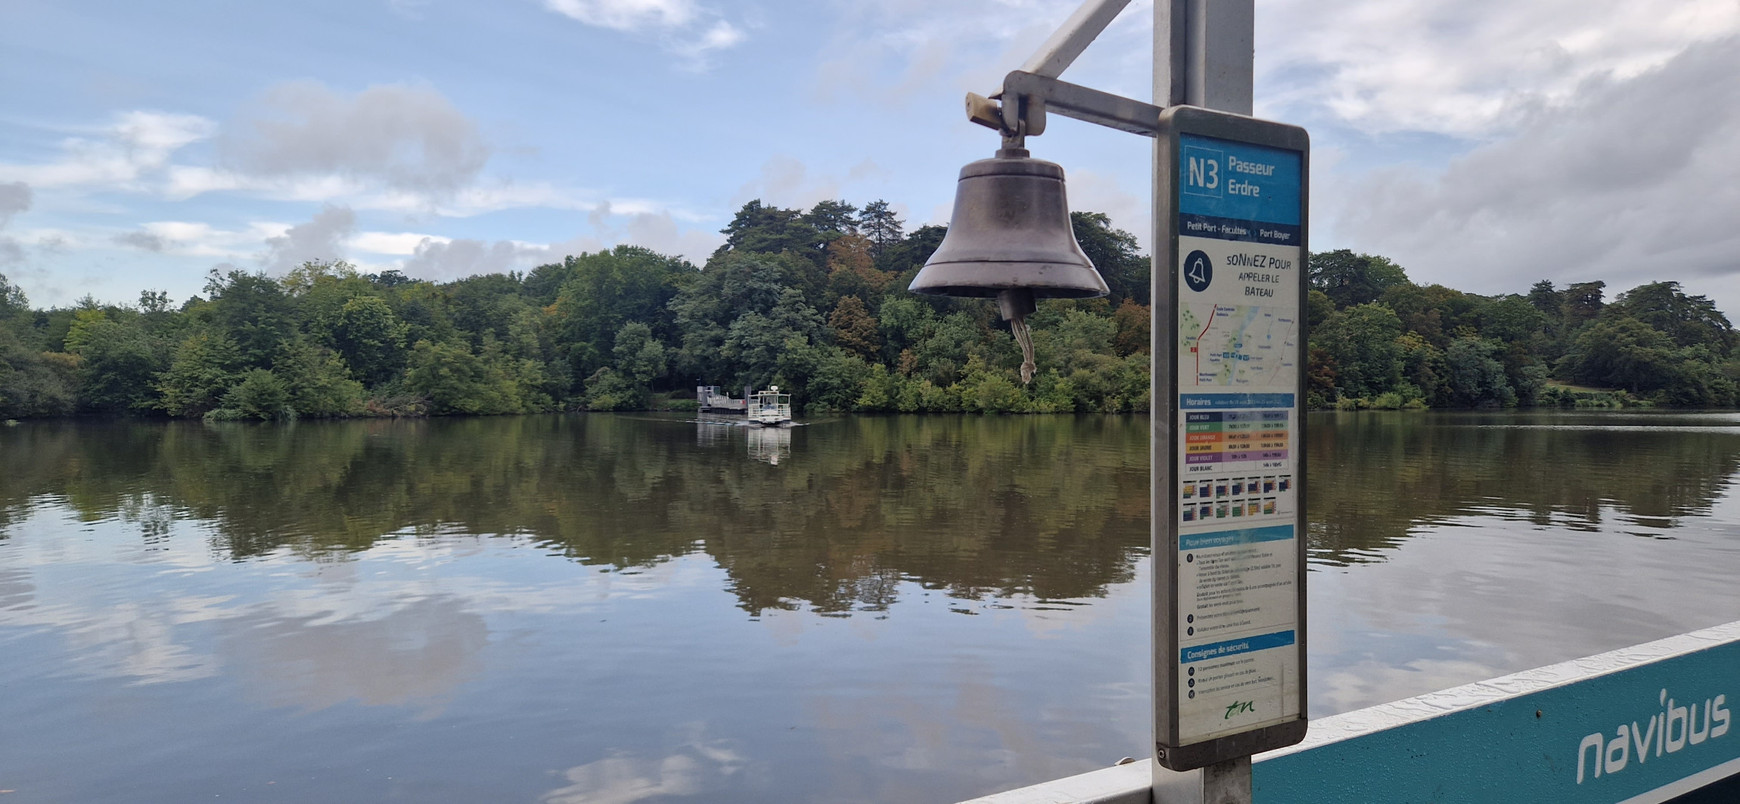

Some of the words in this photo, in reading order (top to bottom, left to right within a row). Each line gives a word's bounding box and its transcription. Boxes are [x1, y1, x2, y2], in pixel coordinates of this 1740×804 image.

[1189, 156, 1219, 189] N3
[1228, 155, 1275, 176] Passeur
[1228, 178, 1260, 197] Erdre
[1187, 221, 1202, 231] Petit
[1203, 223, 1217, 232] Port
[1260, 228, 1273, 238] Port
[1274, 230, 1291, 240] Boyer
[1268, 257, 1292, 270] POUR
[1238, 272, 1270, 283] APPELER
[1271, 274, 1280, 283] LE
[1244, 286, 1274, 298] BATEAU
[1186, 398, 1212, 406] Horaires
[1187, 648, 1217, 659] Consignes
[1227, 642, 1249, 652] sécurité
[1576, 688, 1731, 785] navibus
